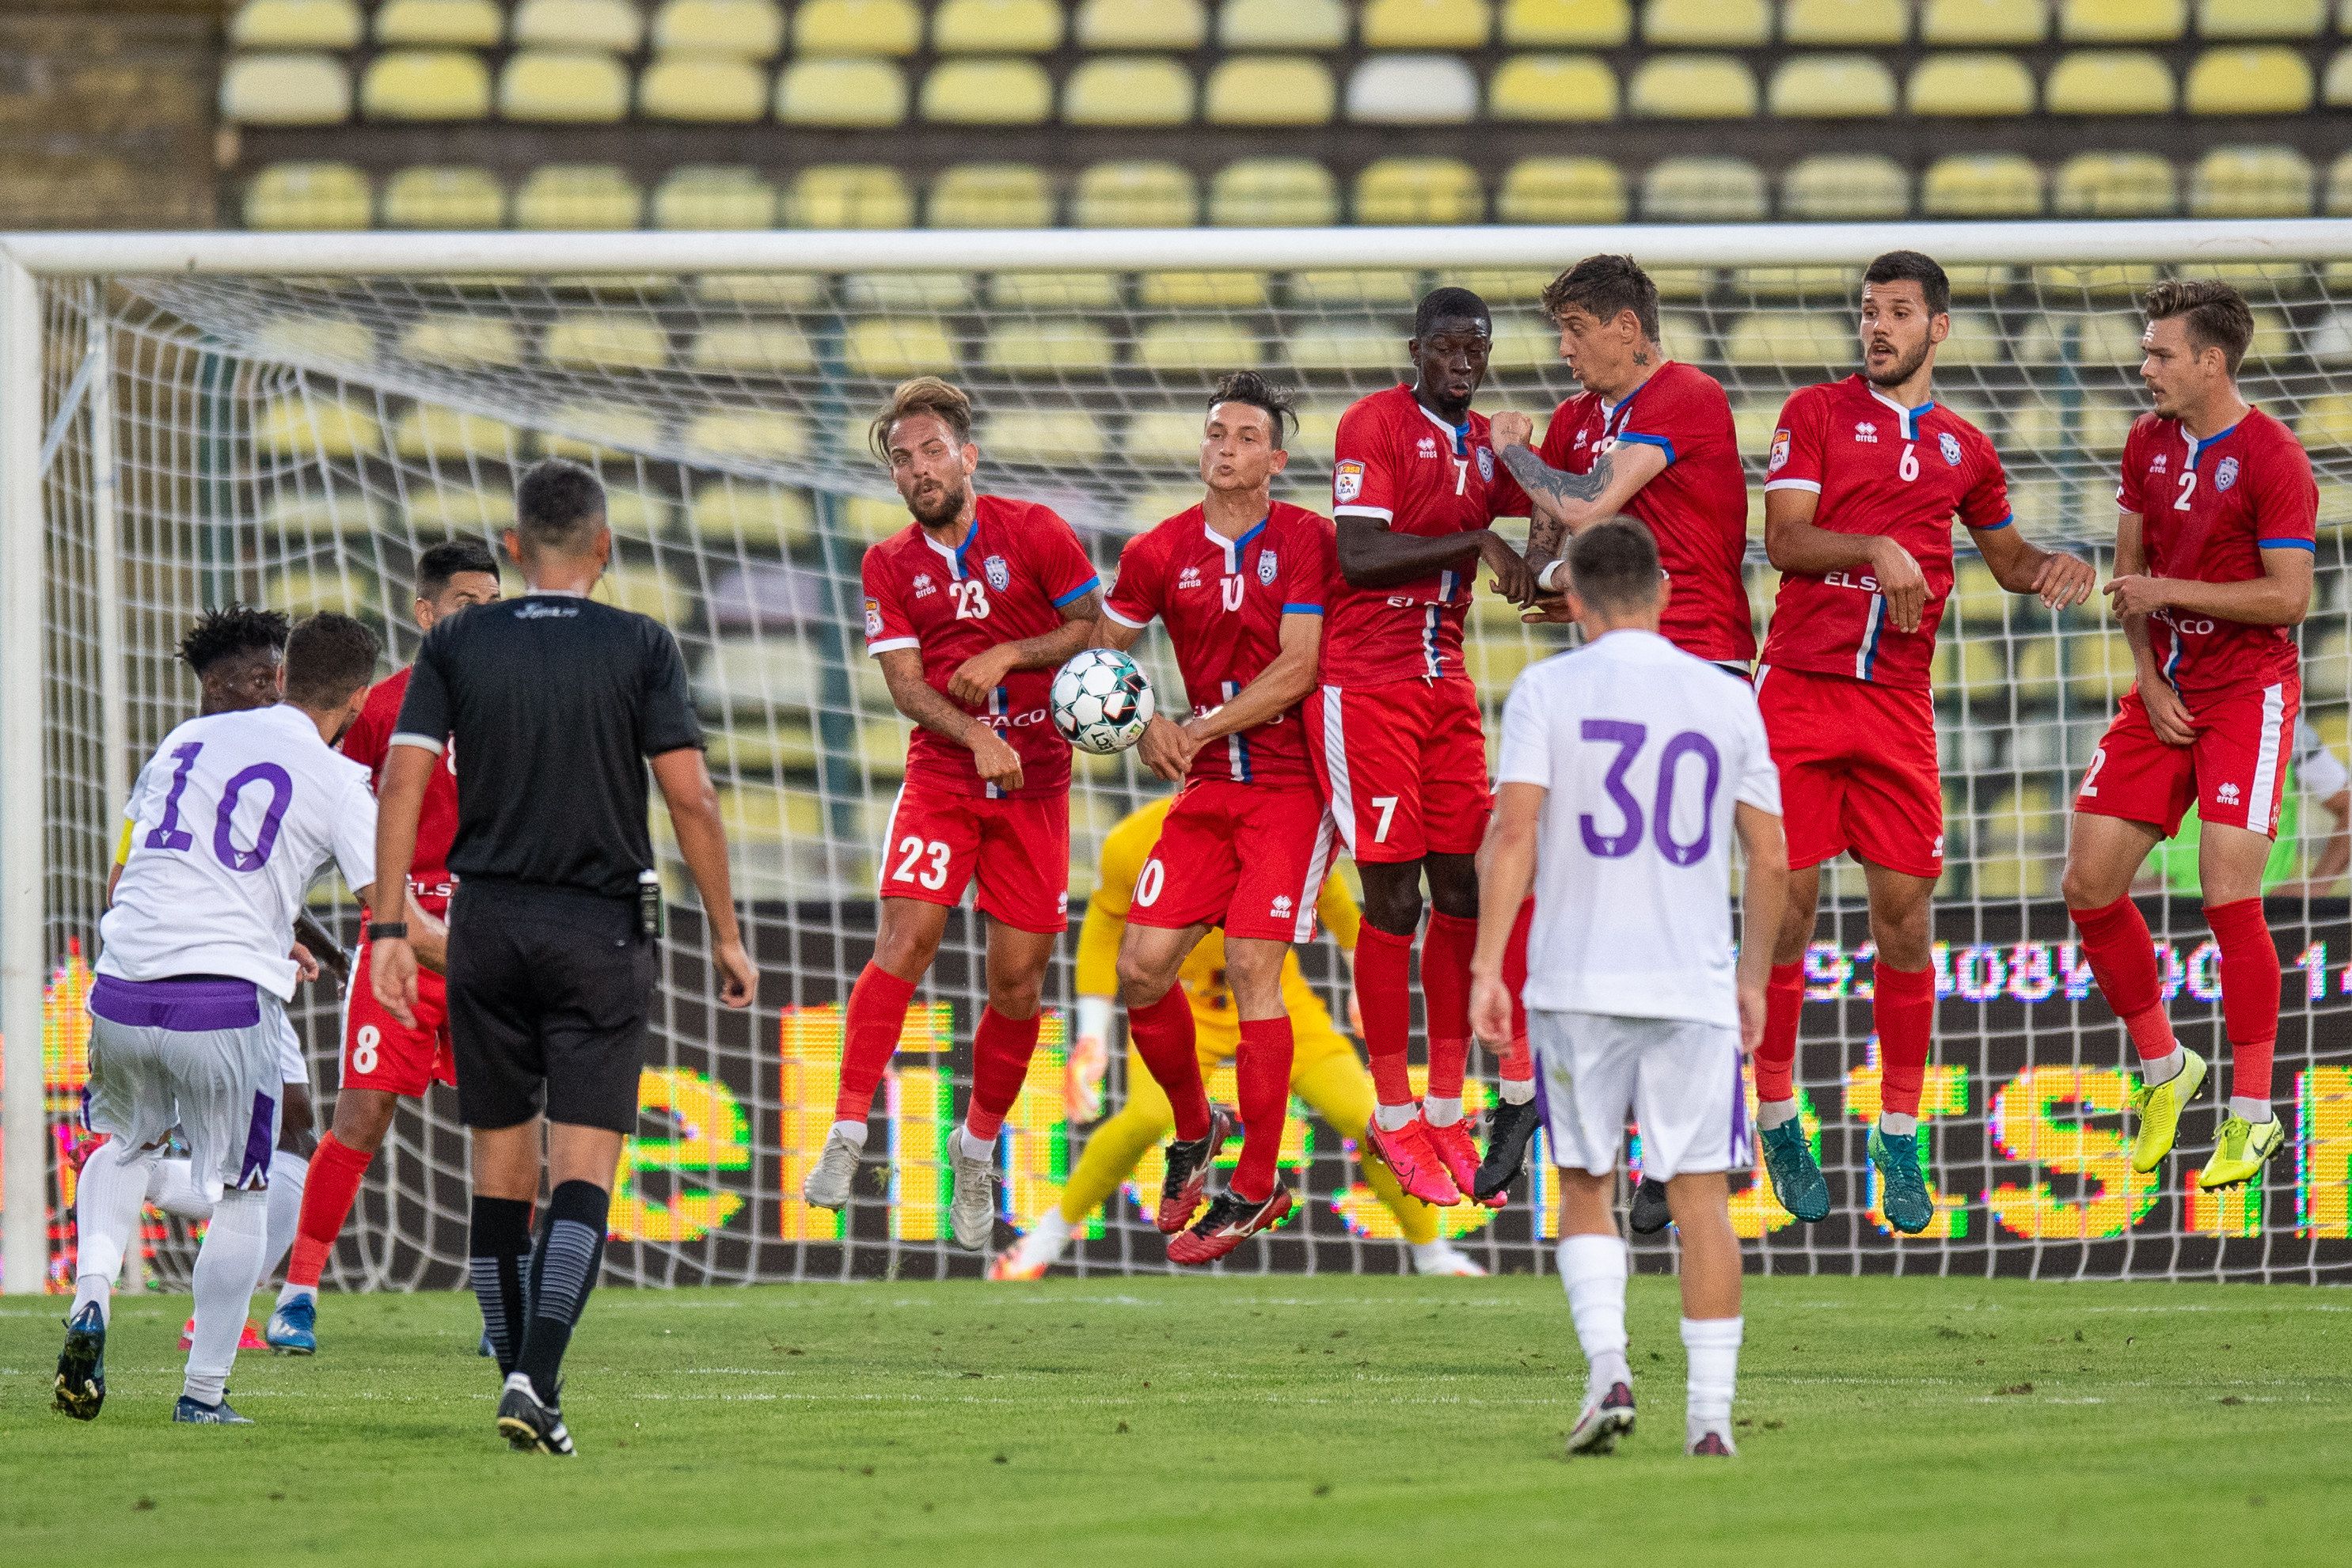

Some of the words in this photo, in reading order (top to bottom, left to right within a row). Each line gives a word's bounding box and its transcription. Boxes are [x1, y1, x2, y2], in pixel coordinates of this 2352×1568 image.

[1899, 443, 1920, 482] 6
[2173, 471, 2198, 511] 2
[949, 580, 990, 621] 23
[1824, 571, 1882, 593] ELS
[1579, 719, 1720, 868] 30
[2080, 748, 2106, 797] 2
[145, 742, 294, 873] 10
[1372, 795, 1399, 843] 7
[892, 836, 951, 890] 23
[353, 1025, 380, 1074] 8
